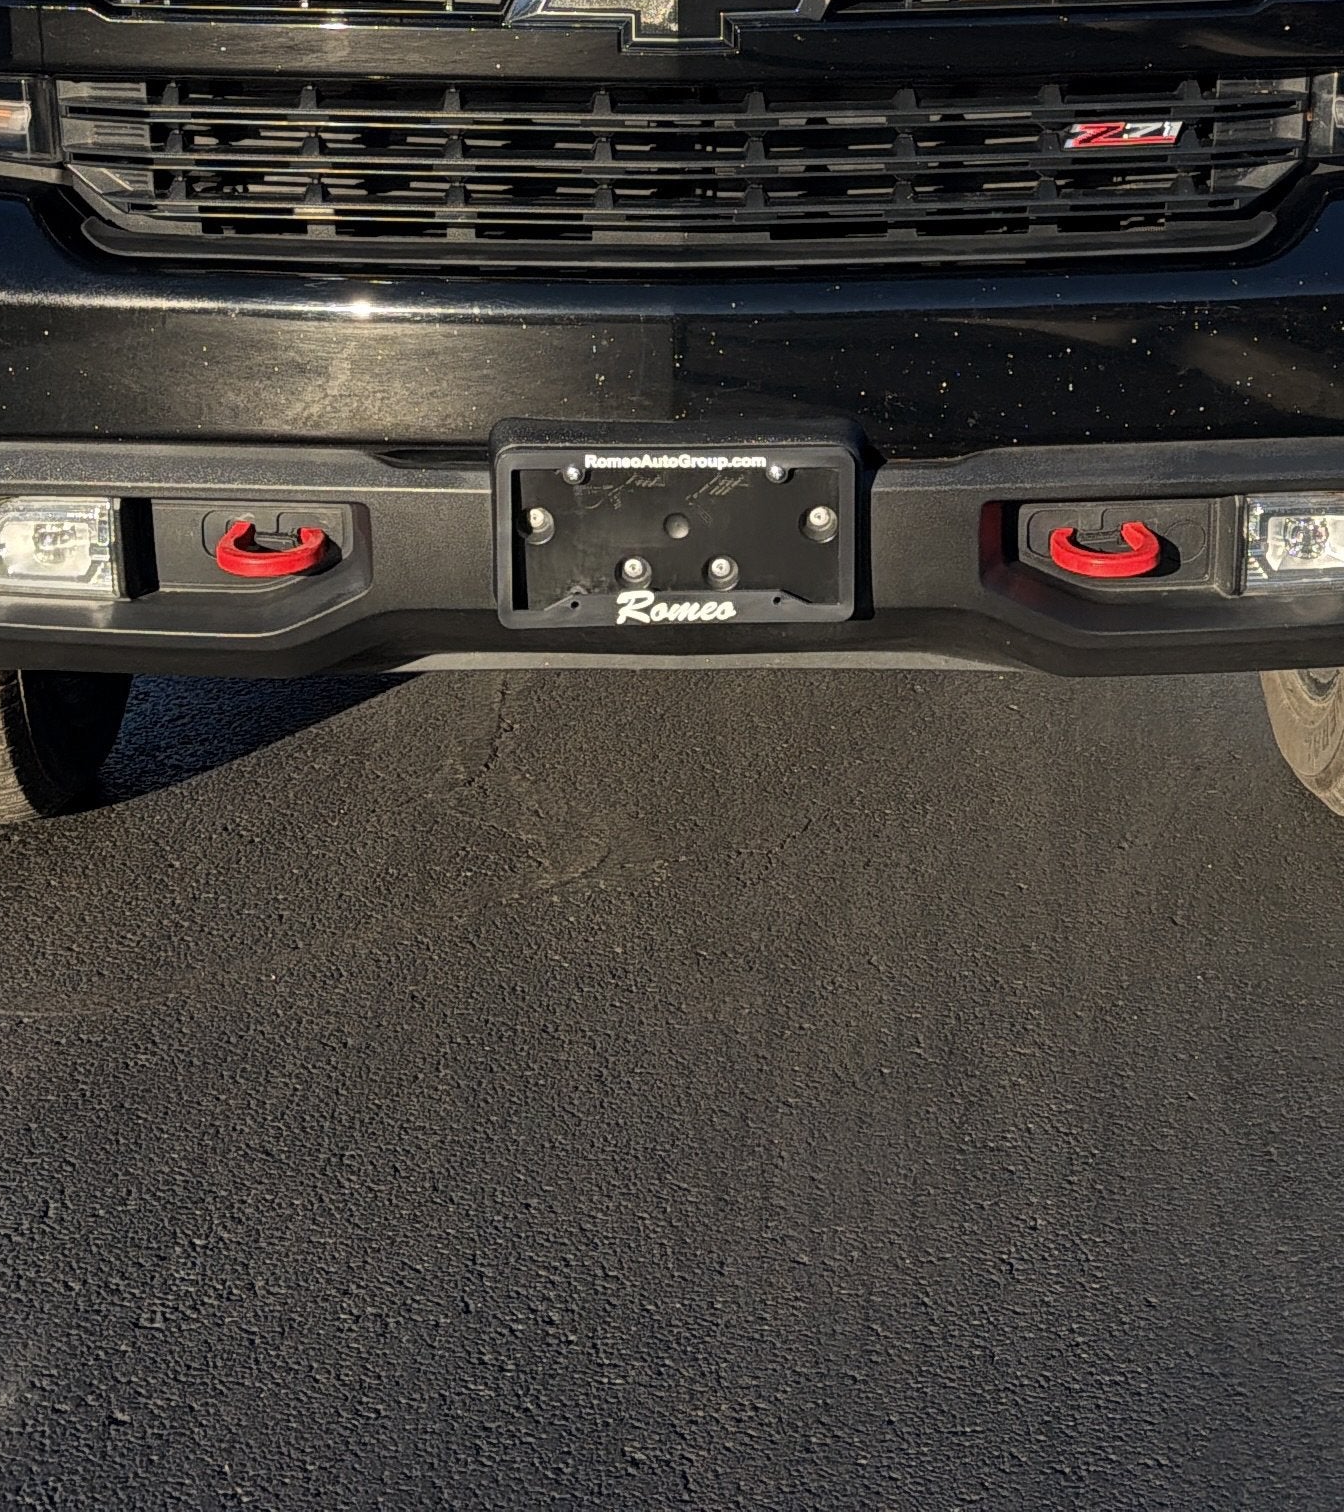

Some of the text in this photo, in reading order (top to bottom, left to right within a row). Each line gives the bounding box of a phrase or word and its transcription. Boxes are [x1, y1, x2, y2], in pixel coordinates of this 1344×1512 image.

[1064, 121, 1183, 148] Z71
[584, 454, 768, 471] RomeoAutoGroup.com
[616, 590, 737, 625] Romeo
